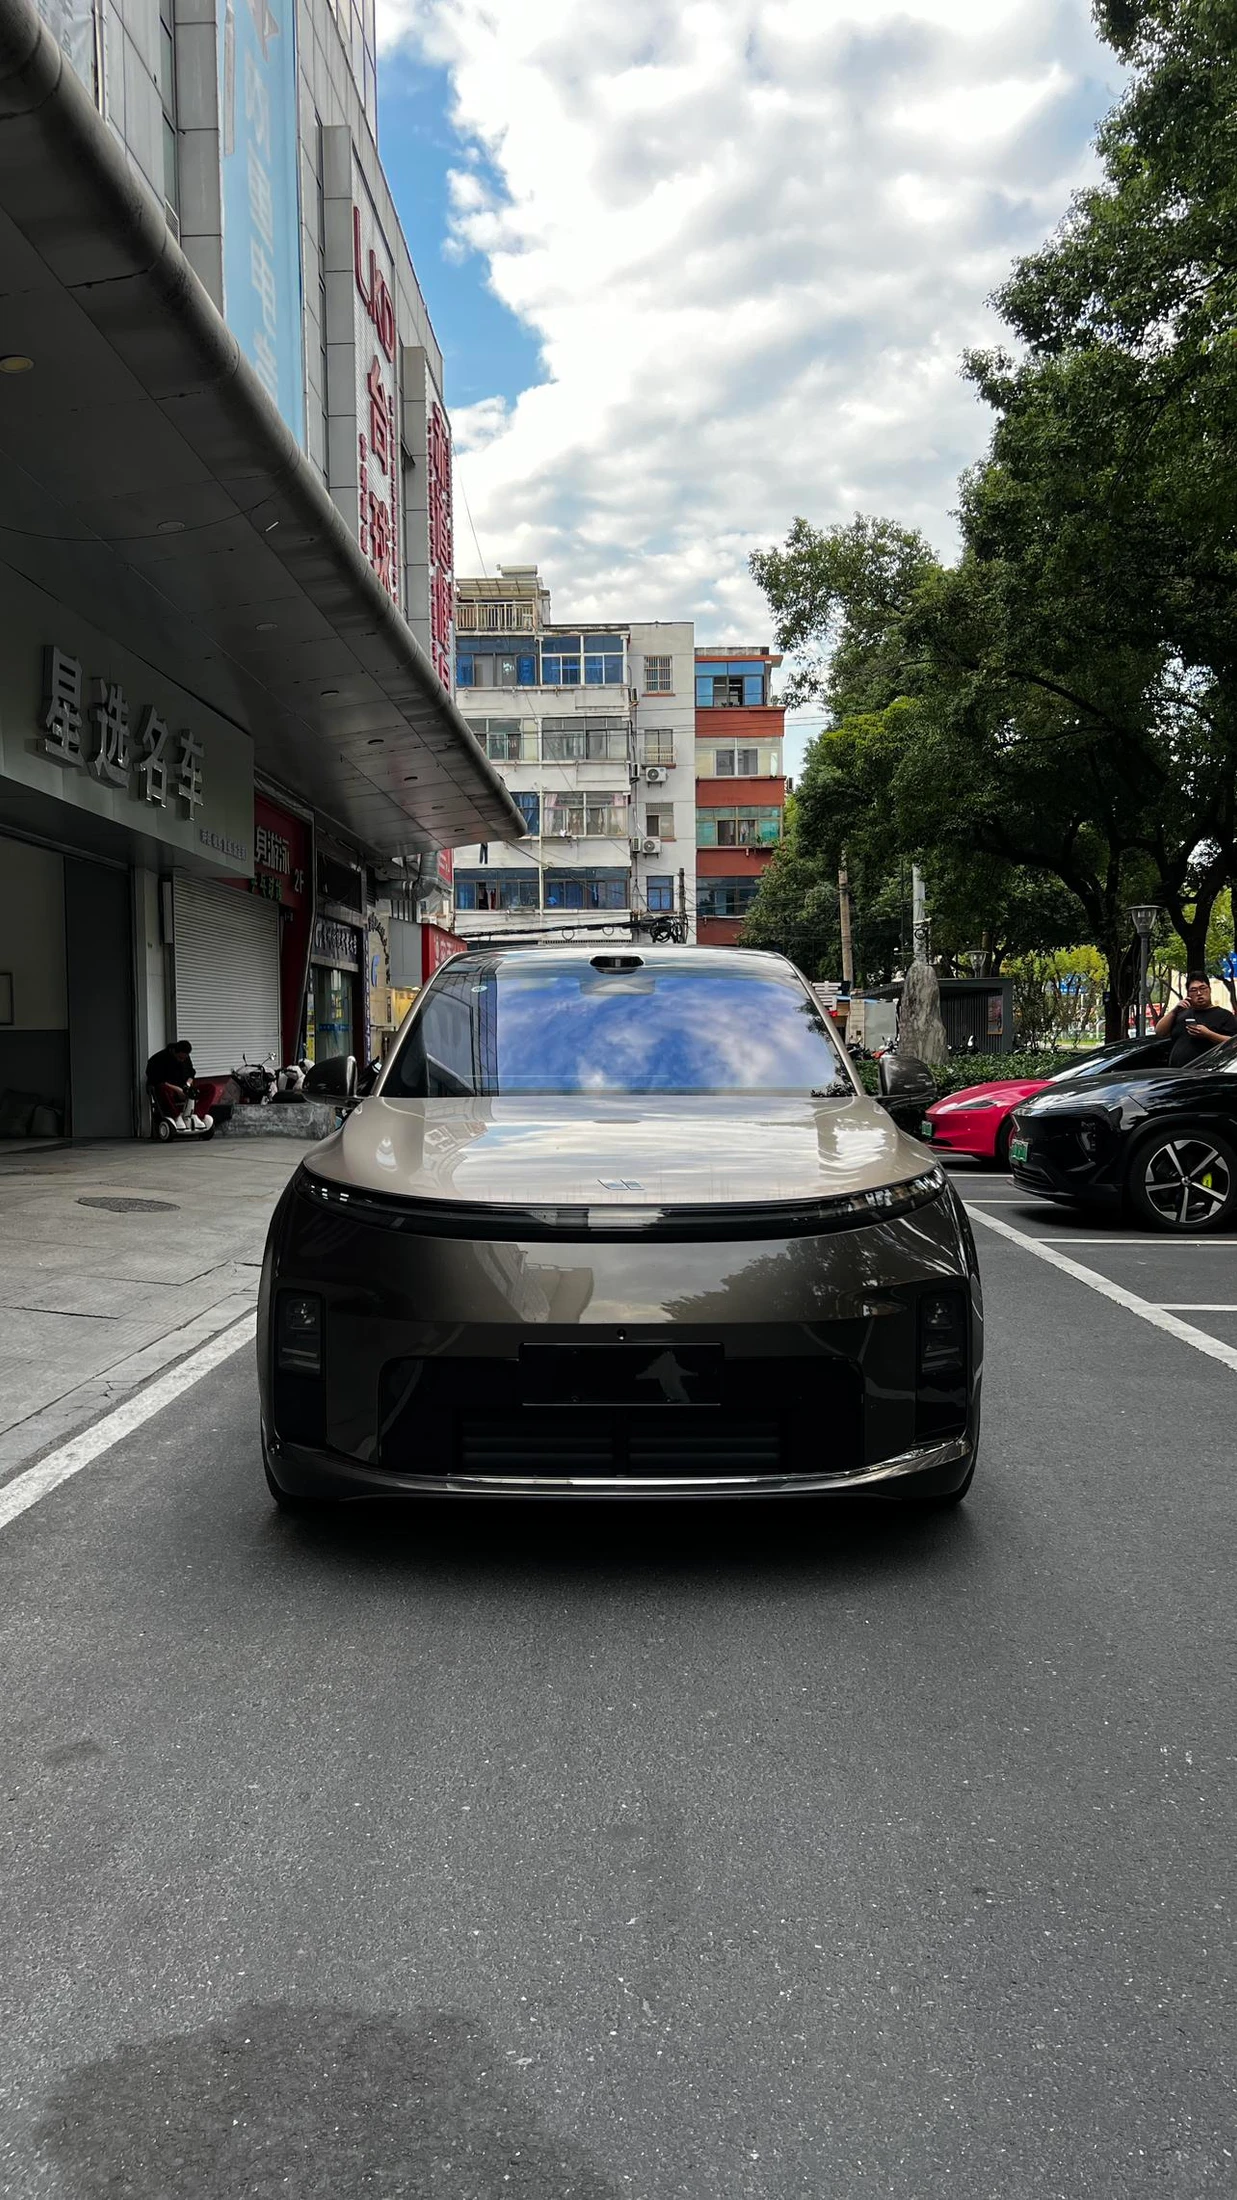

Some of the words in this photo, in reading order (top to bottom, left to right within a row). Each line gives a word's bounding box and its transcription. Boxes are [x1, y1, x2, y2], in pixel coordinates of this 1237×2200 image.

[42, 645, 205, 821] 星选名车
[294, 868, 305, 894] 2F
